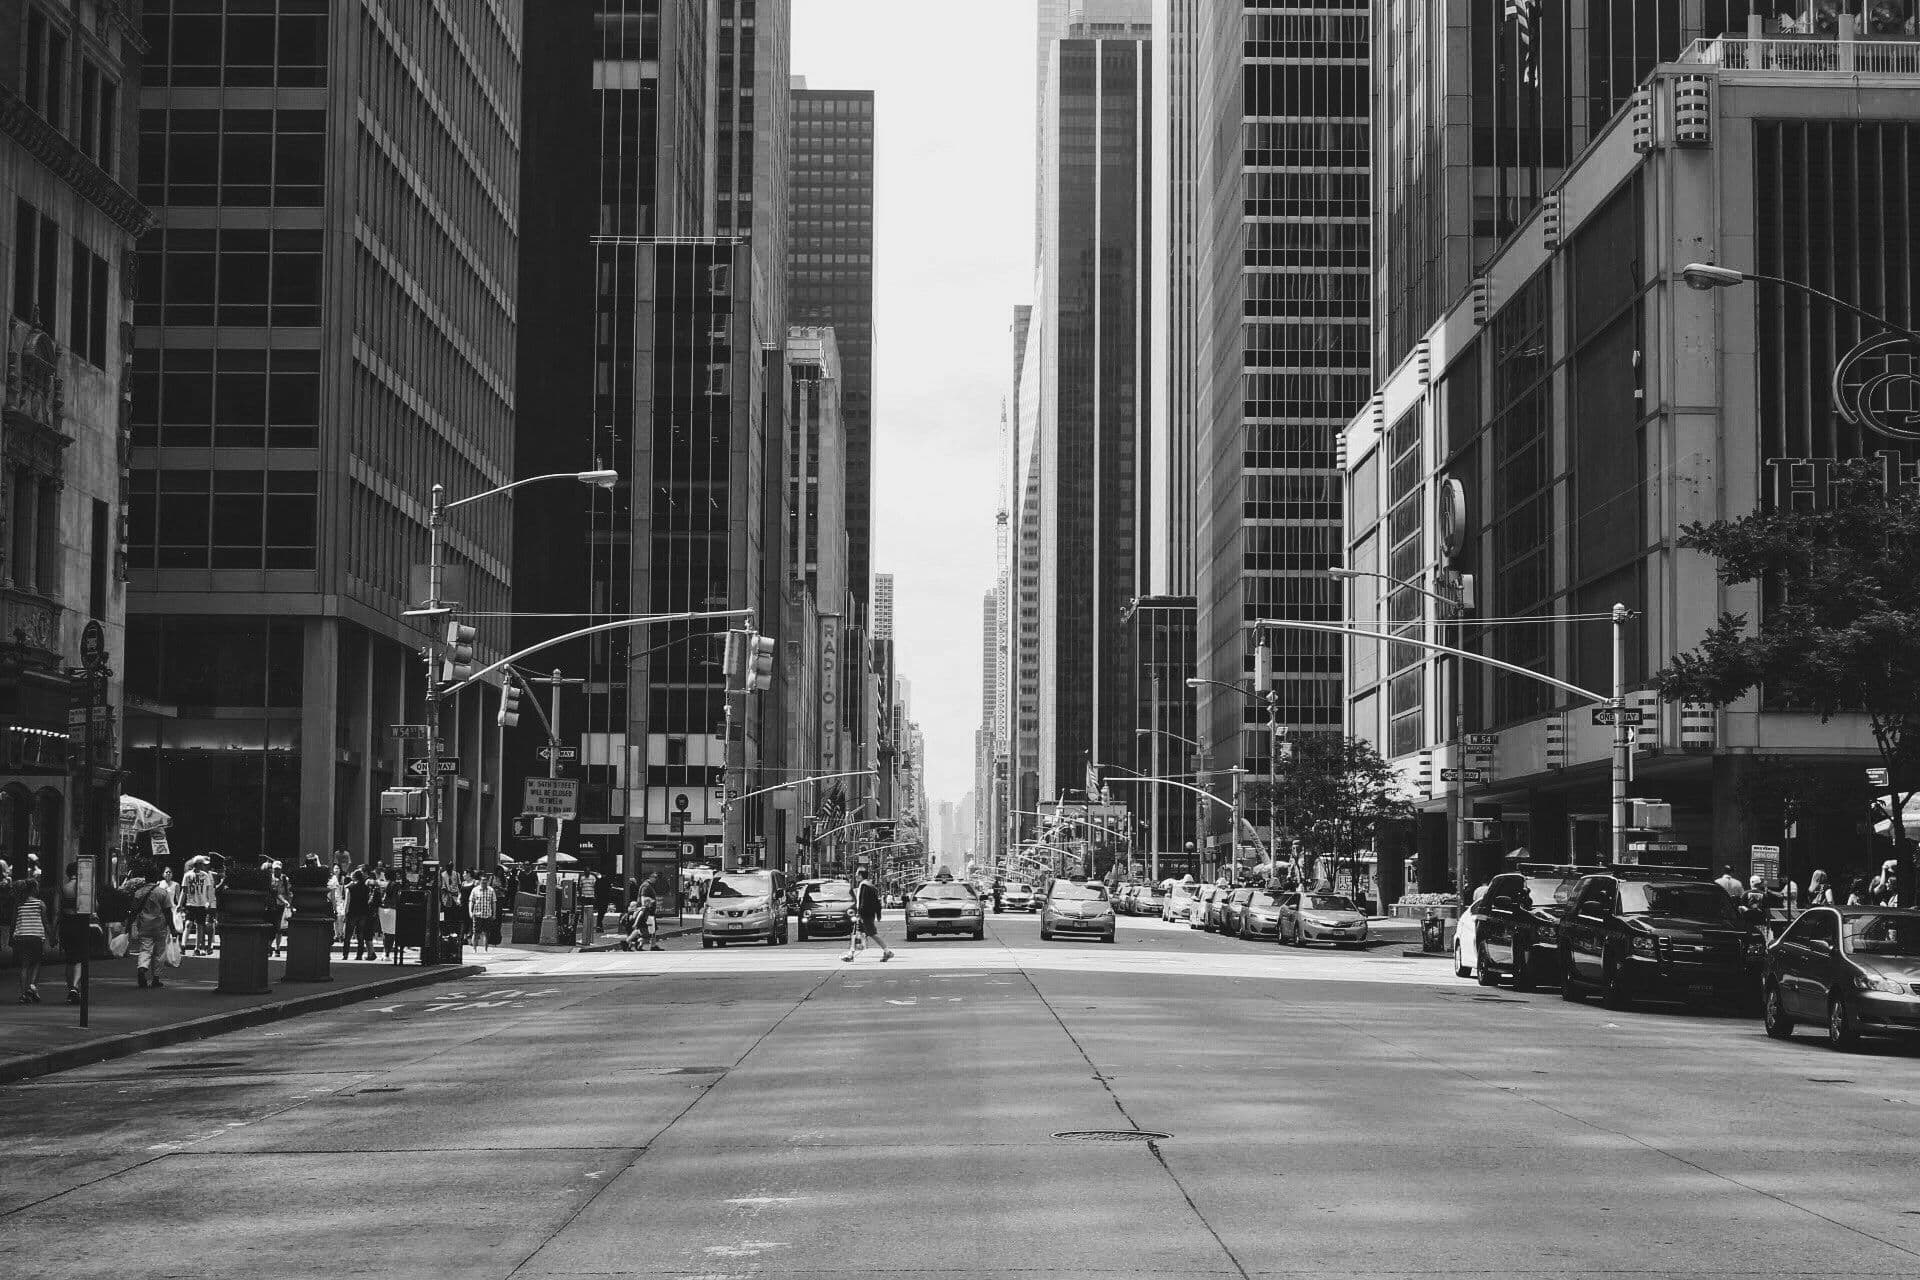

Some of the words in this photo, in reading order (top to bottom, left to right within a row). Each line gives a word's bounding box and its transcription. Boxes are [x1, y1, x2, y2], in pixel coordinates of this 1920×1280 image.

[822, 624, 835, 704] RADIO
[392, 727, 398, 737] W
[399, 727, 410, 737] 54
[1481, 736, 1491, 744] 54
